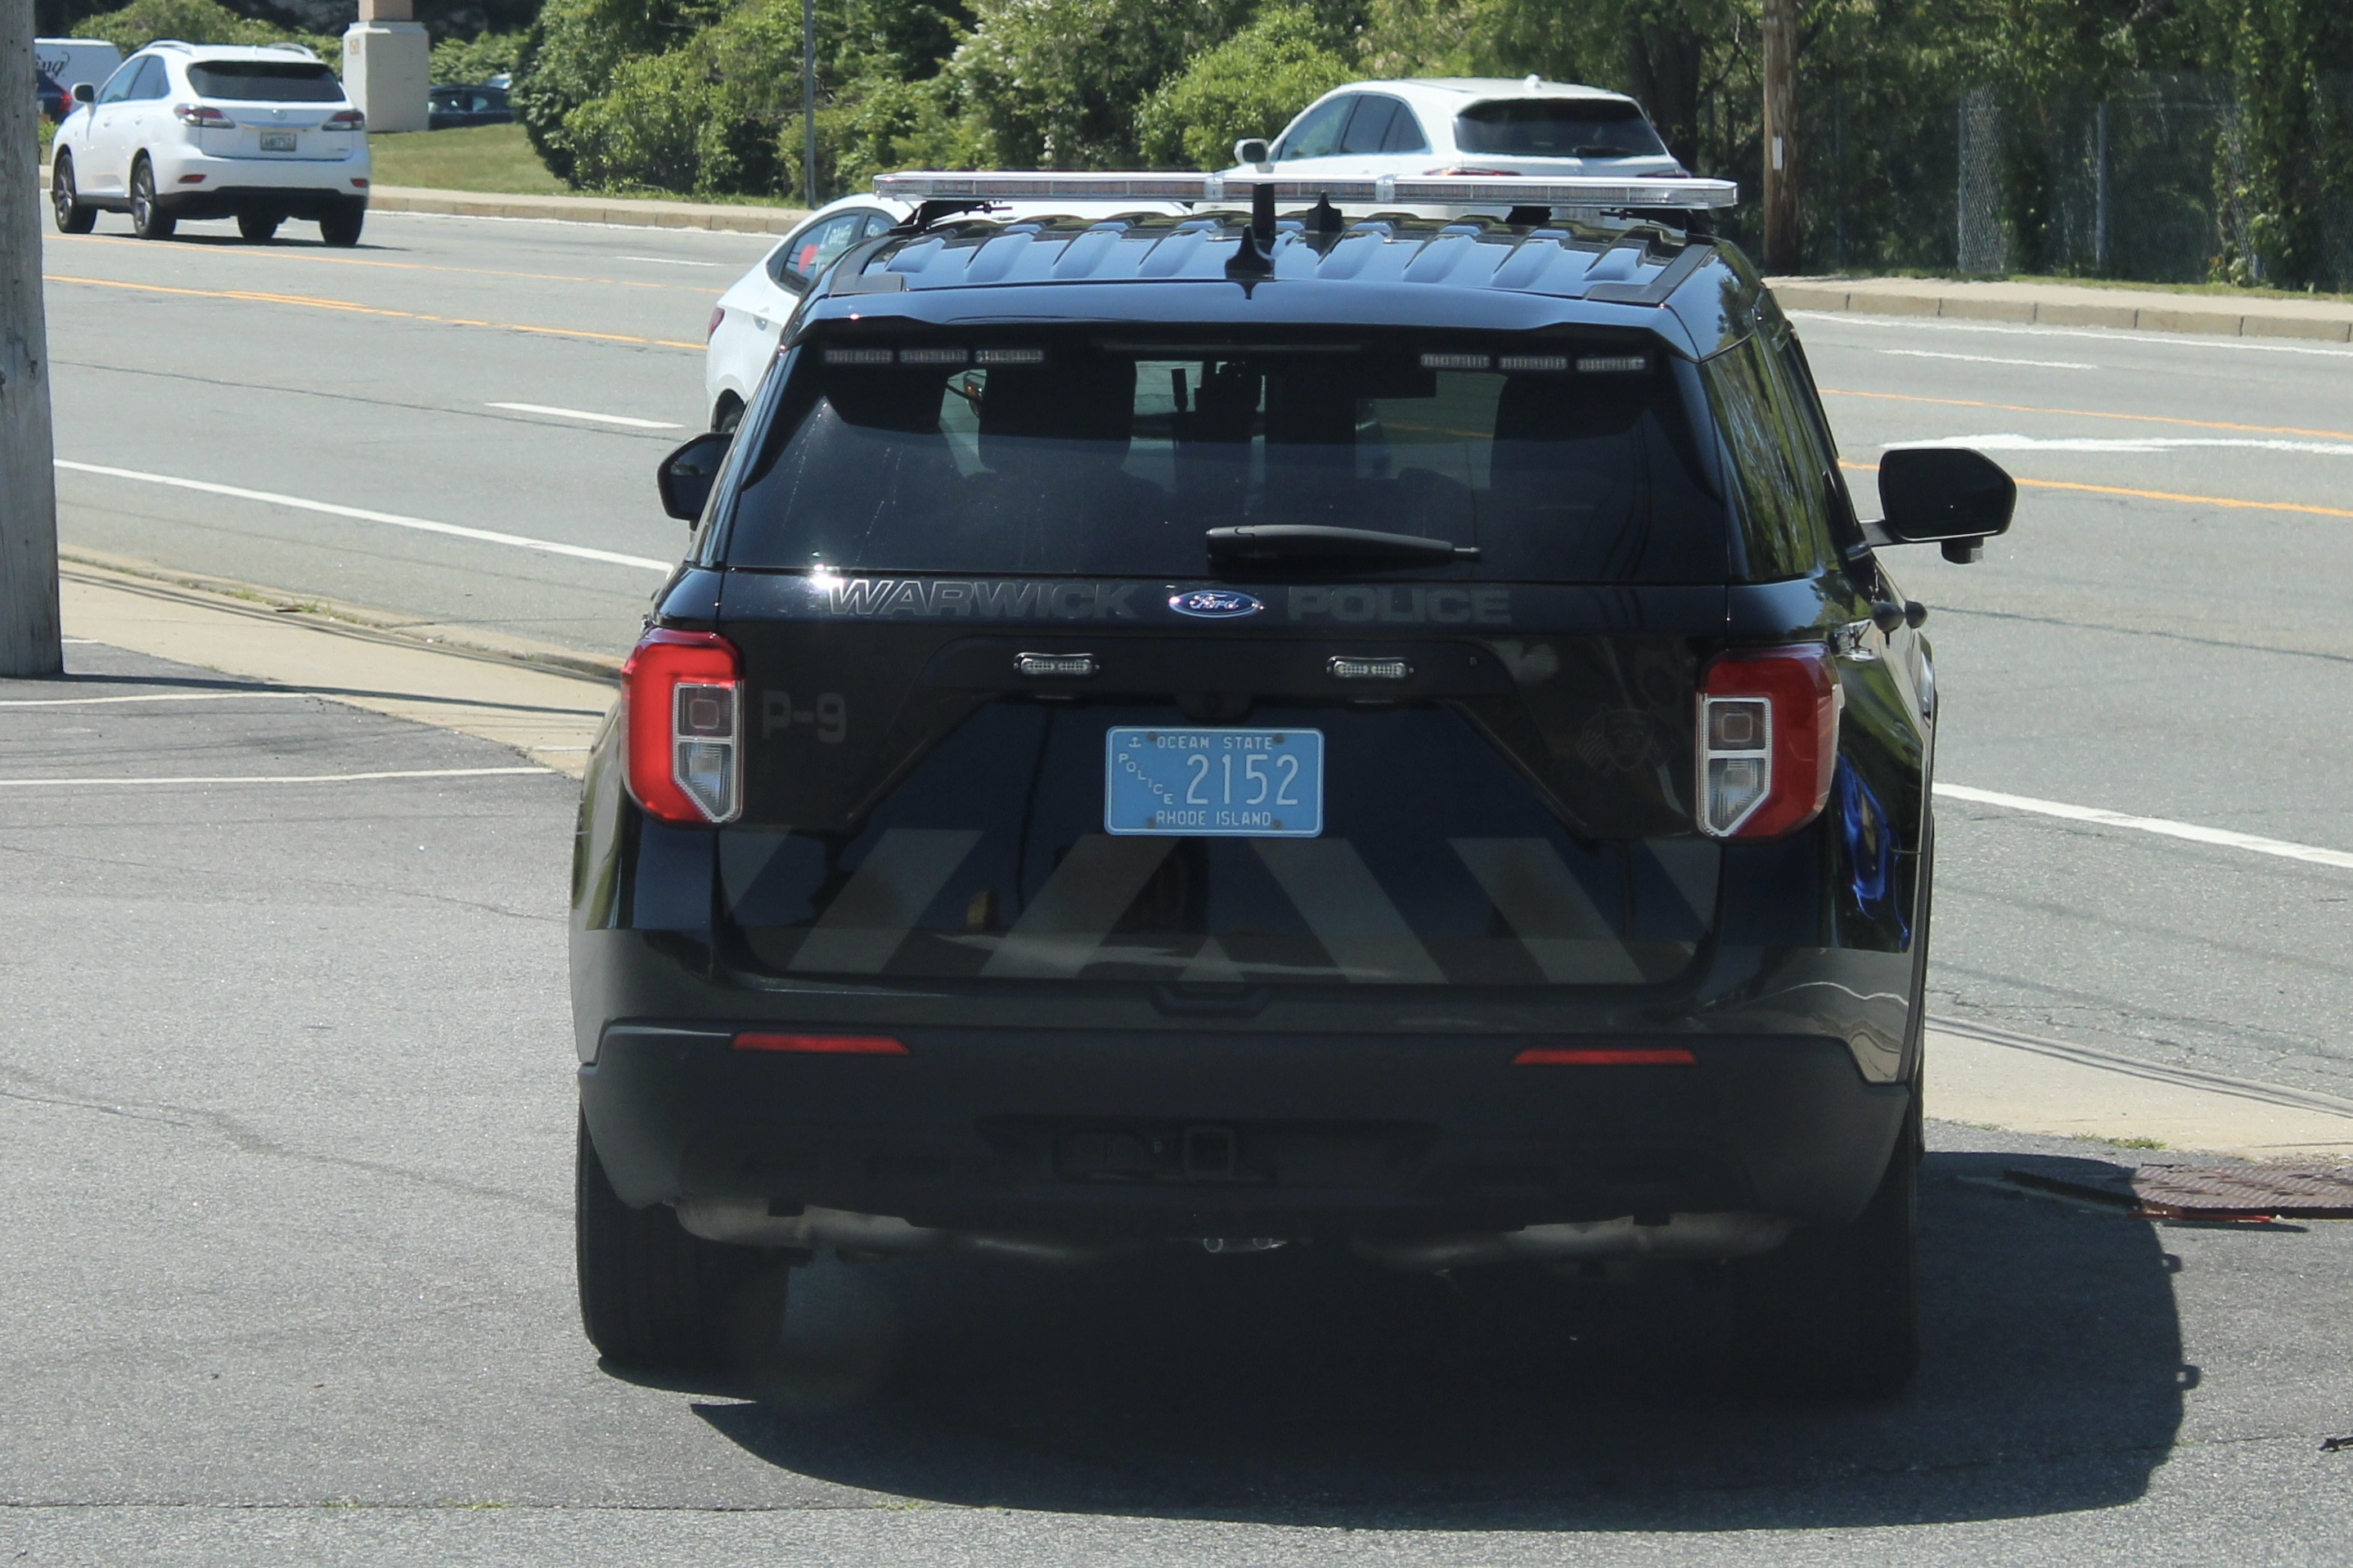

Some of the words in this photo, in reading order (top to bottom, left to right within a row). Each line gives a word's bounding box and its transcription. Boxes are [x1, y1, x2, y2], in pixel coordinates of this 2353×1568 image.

[828, 579, 1136, 619] WARWICK
[1190, 594, 1240, 609] Ford
[1288, 586, 1512, 623] POLICE
[762, 690, 847, 744] P-9
[1157, 736, 1209, 749] OCEAN
[1223, 737, 1273, 750] STATE
[1118, 753, 1173, 804] POLICE
[1186, 753, 1299, 806] 2152
[1155, 810, 1207, 825] RHODE
[1216, 811, 1271, 826] ISLAND
